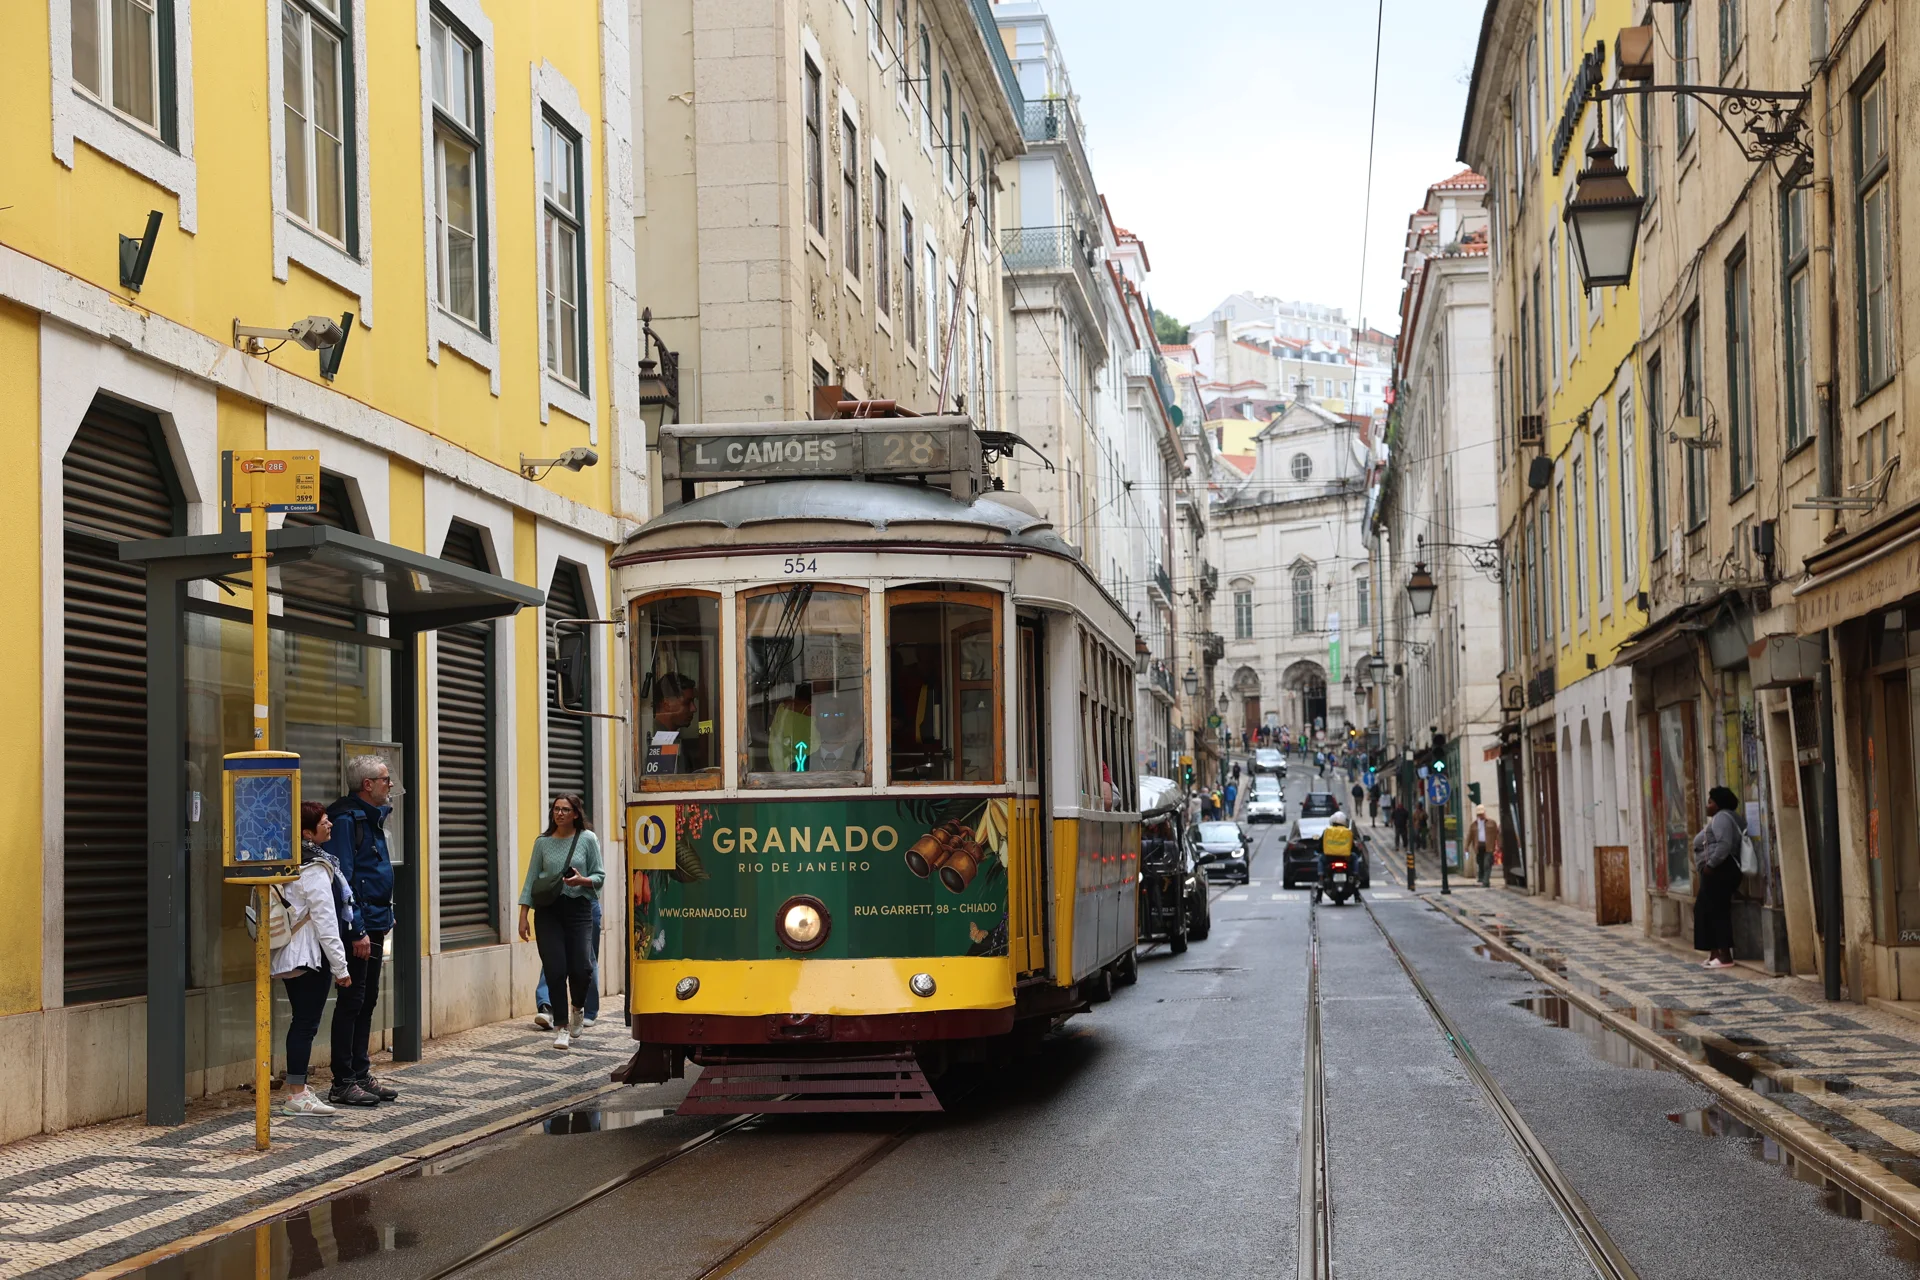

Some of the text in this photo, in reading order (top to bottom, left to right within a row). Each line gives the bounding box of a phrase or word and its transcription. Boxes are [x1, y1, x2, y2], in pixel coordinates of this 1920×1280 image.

[696, 444, 717, 465] L.
[884, 434, 935, 466] 28
[269, 463, 284, 471] 28E
[784, 558, 818, 574] 554
[698, 727, 711, 735] 320
[647, 762, 659, 772] 06
[712, 825, 899, 854] GRANADO
[739, 861, 871, 873] RIO DE JANEIRO
[658, 907, 747, 919] WWW.GRANADO.EU
[854, 905, 878, 916] RUA
[880, 904, 934, 917] GARRETT,
[936, 903, 949, 915] 98
[959, 902, 997, 914] CHIADO
